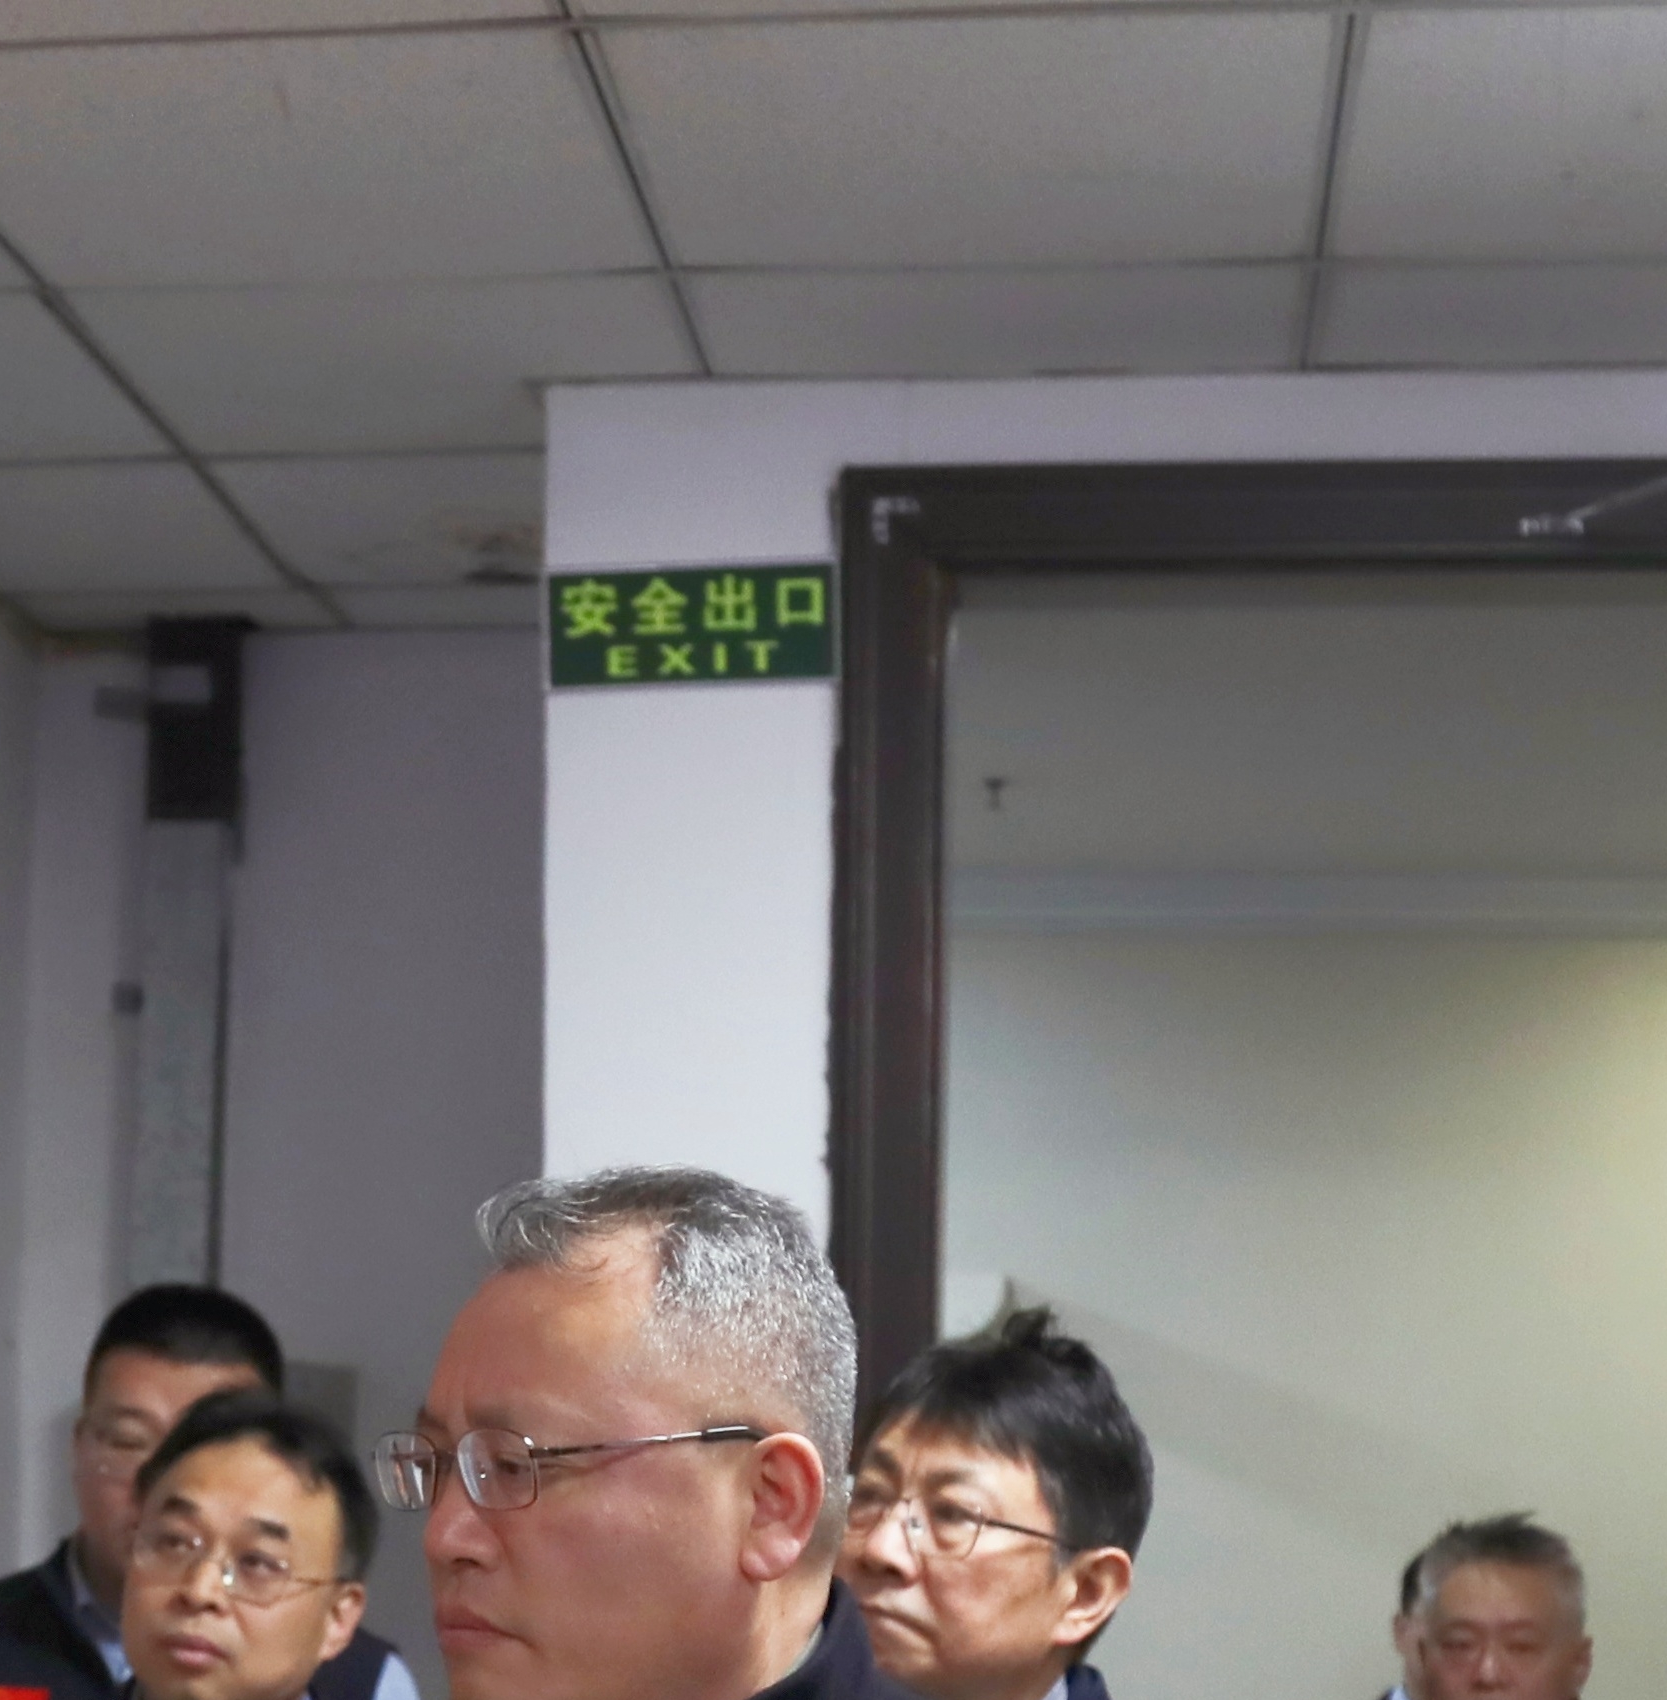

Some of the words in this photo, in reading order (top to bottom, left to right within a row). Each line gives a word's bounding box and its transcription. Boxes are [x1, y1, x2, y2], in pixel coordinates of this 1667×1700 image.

[561, 574, 824, 639] 安全出口
[606, 640, 779, 678] EXIT
